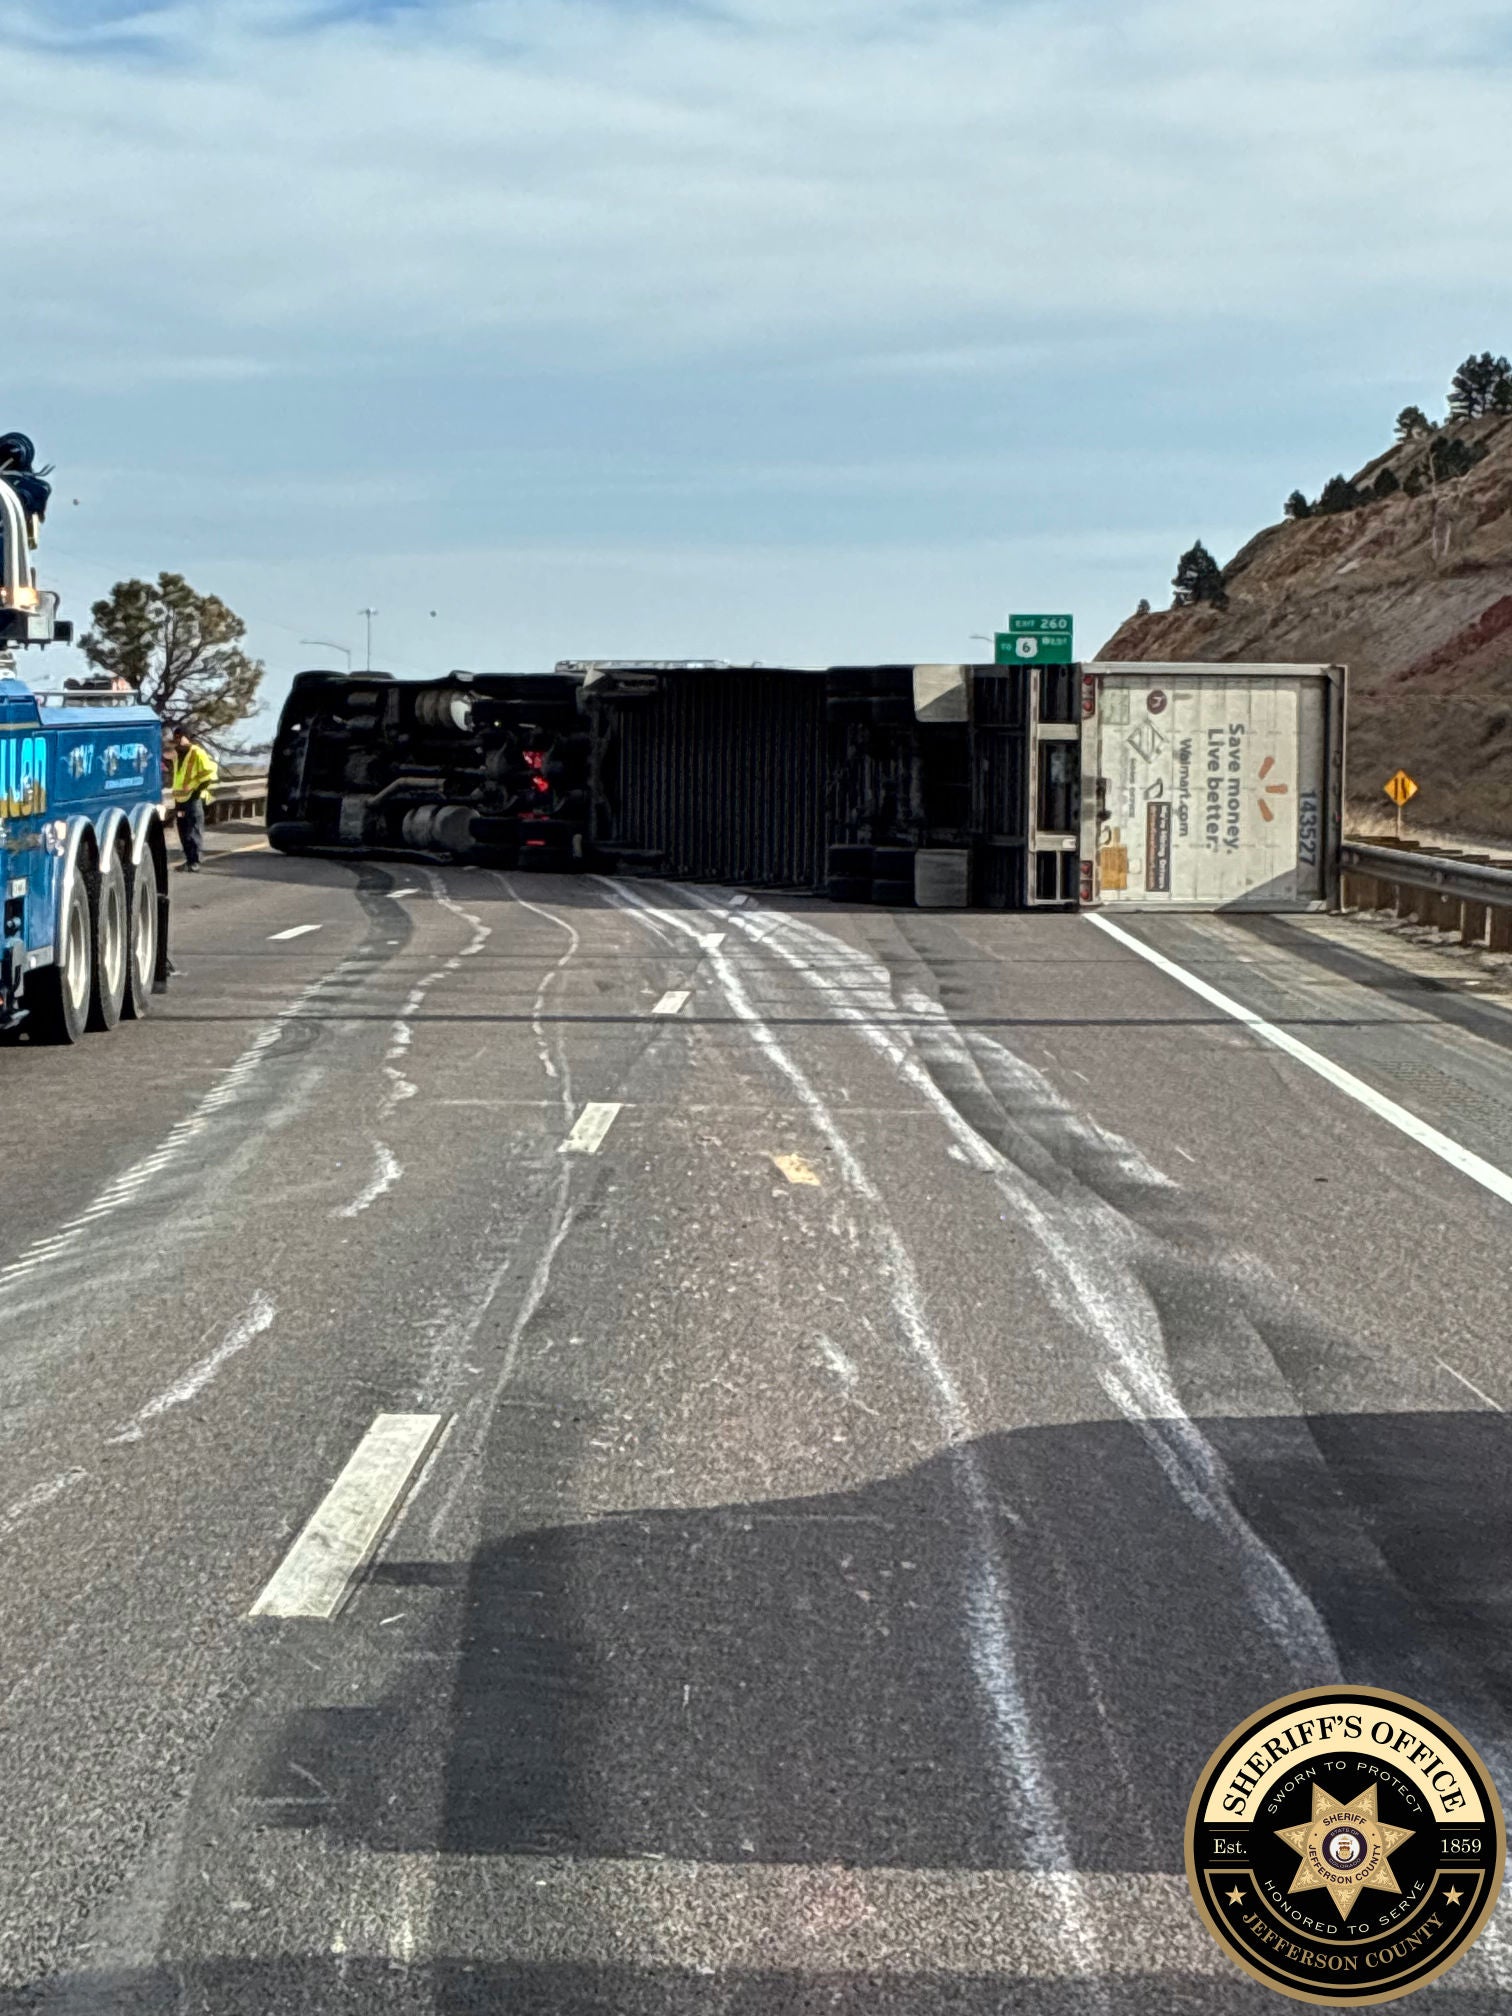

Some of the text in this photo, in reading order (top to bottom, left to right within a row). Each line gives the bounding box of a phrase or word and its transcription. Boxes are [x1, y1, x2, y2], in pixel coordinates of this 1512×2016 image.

[1015, 618, 1068, 629] EXIT 260
[1022, 642, 1031, 653] 6
[1178, 737, 1193, 837] Walmart.com
[1206, 728, 1225, 850] Live better.
[1223, 723, 1245, 855] Save money.
[1299, 790, 1317, 866] 143527
